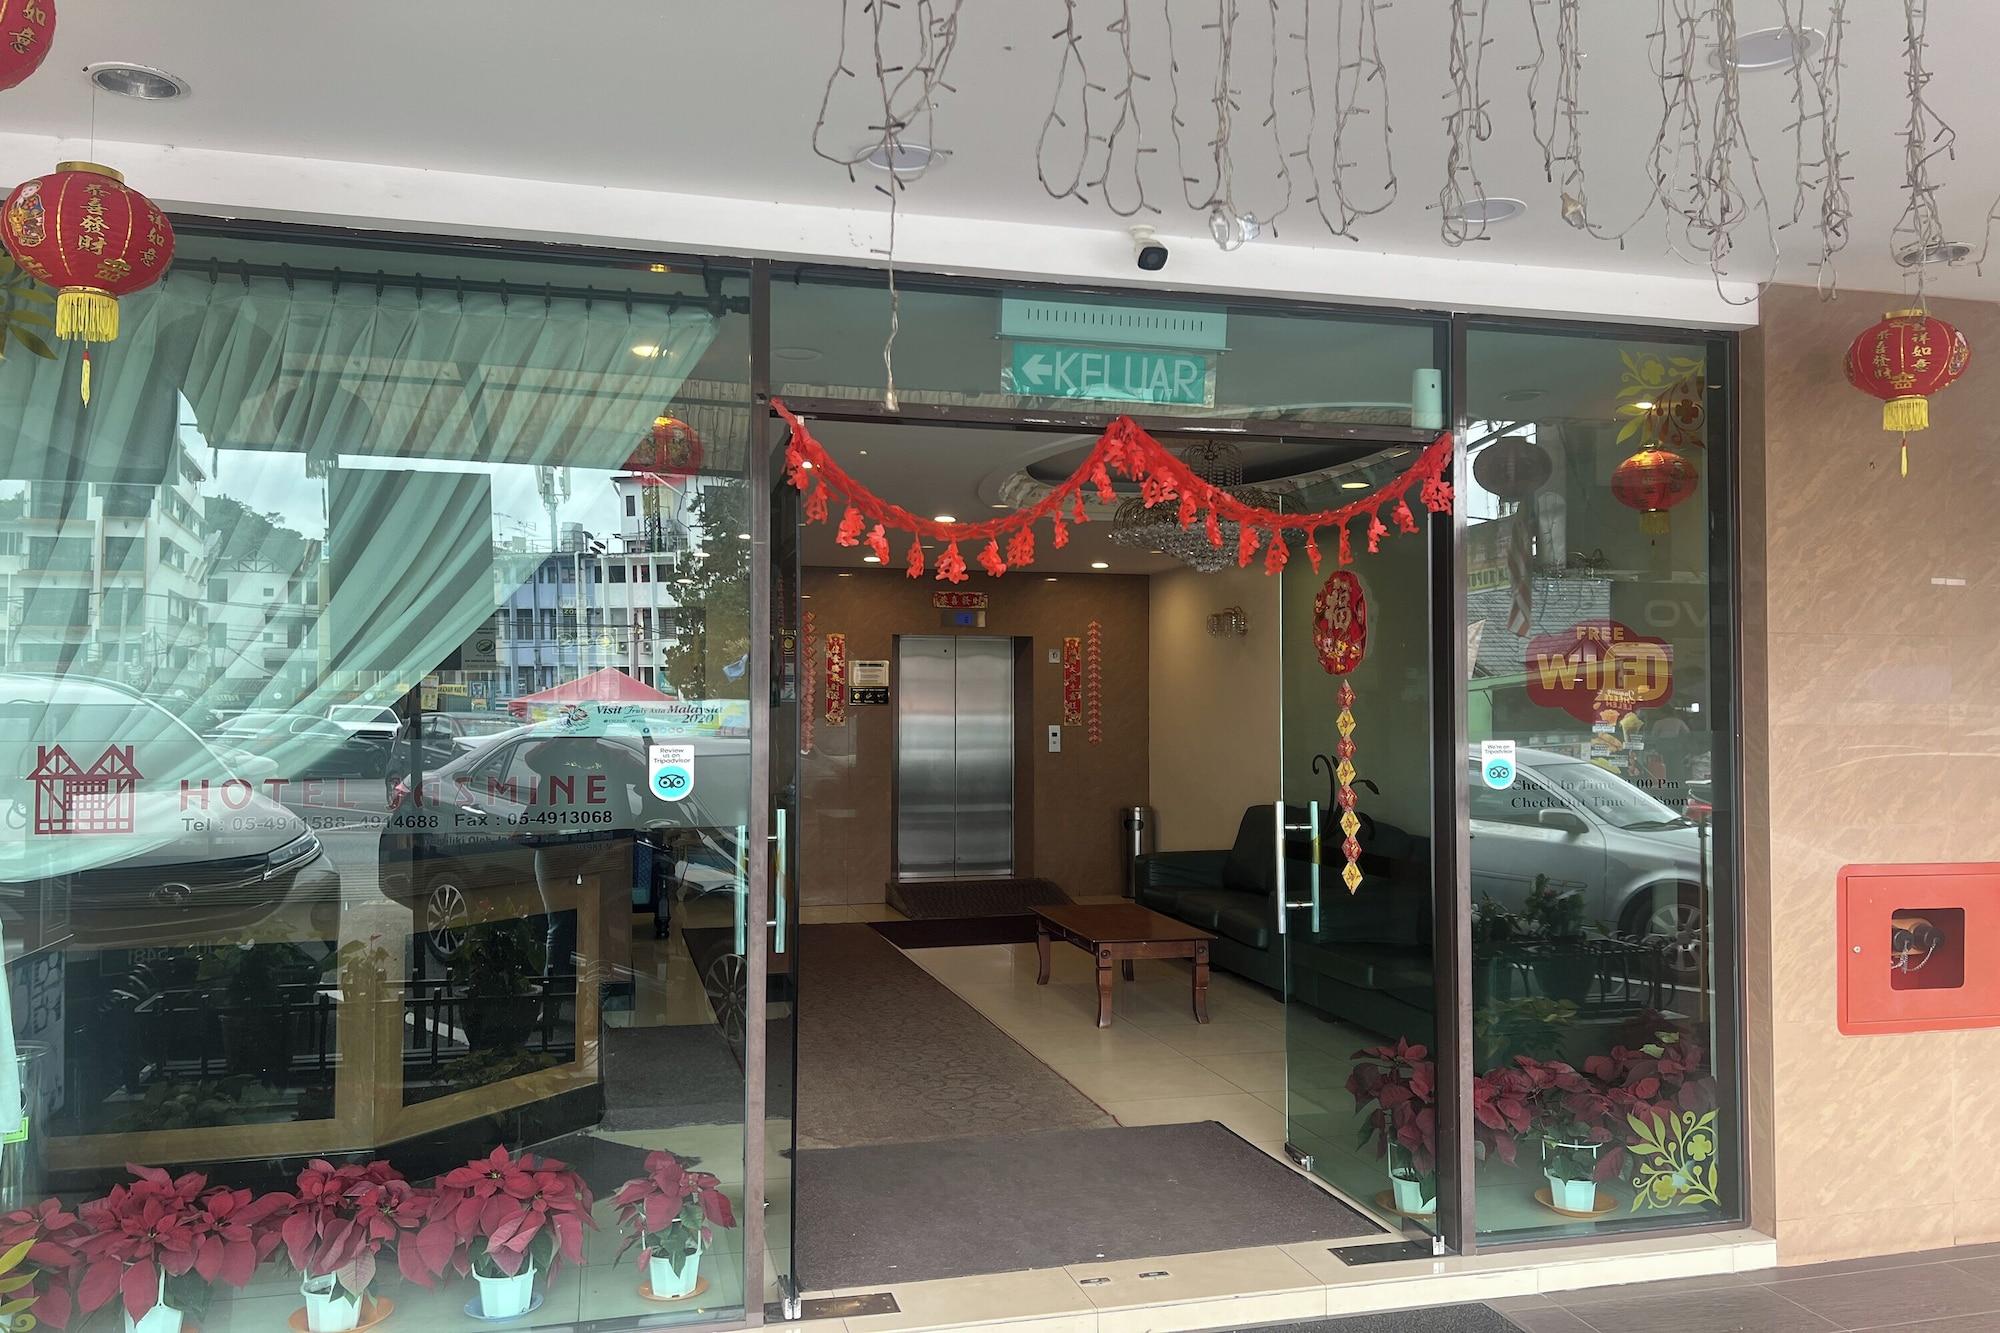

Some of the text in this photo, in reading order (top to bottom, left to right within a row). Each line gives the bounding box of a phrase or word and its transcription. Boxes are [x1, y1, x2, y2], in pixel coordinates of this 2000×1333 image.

[77, 183, 112, 256] 恭喜發財
[1054, 351, 1199, 399] KELUAR
[1576, 626, 1625, 641] FREE
[595, 705, 623, 715] Visit
[667, 704, 724, 715] Malaysia
[681, 713, 715, 724] 2020
[1658, 778, 1679, 789] Pm
[180, 778, 357, 812] HOTEL
[1511, 796, 1557, 808] Check
[181, 817, 211, 832] Tel
[359, 814, 440, 830] 4914688
[454, 813, 489, 828] Fax
[507, 809, 613, 825] 05-4913068
